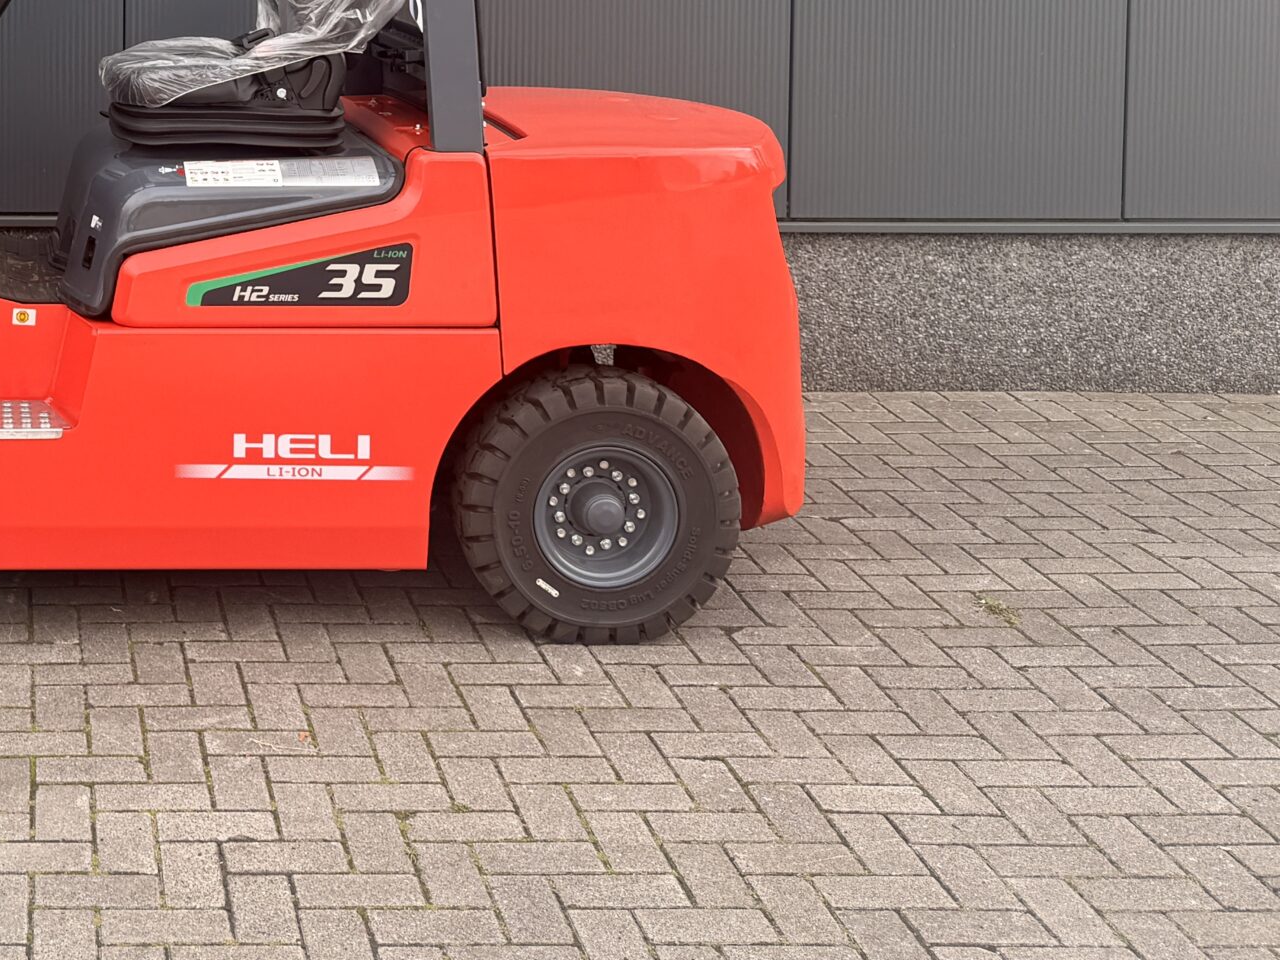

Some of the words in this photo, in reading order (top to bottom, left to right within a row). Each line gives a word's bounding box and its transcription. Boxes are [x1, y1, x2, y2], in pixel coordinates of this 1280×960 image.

[373, 250, 407, 258] LI-ION
[233, 286, 269, 302] H2
[269, 293, 299, 302] SERIES
[319, 264, 400, 298] 35
[233, 434, 371, 460] HELI
[622, 422, 693, 481] ADVANCE
[267, 467, 323, 477] LI-ION
